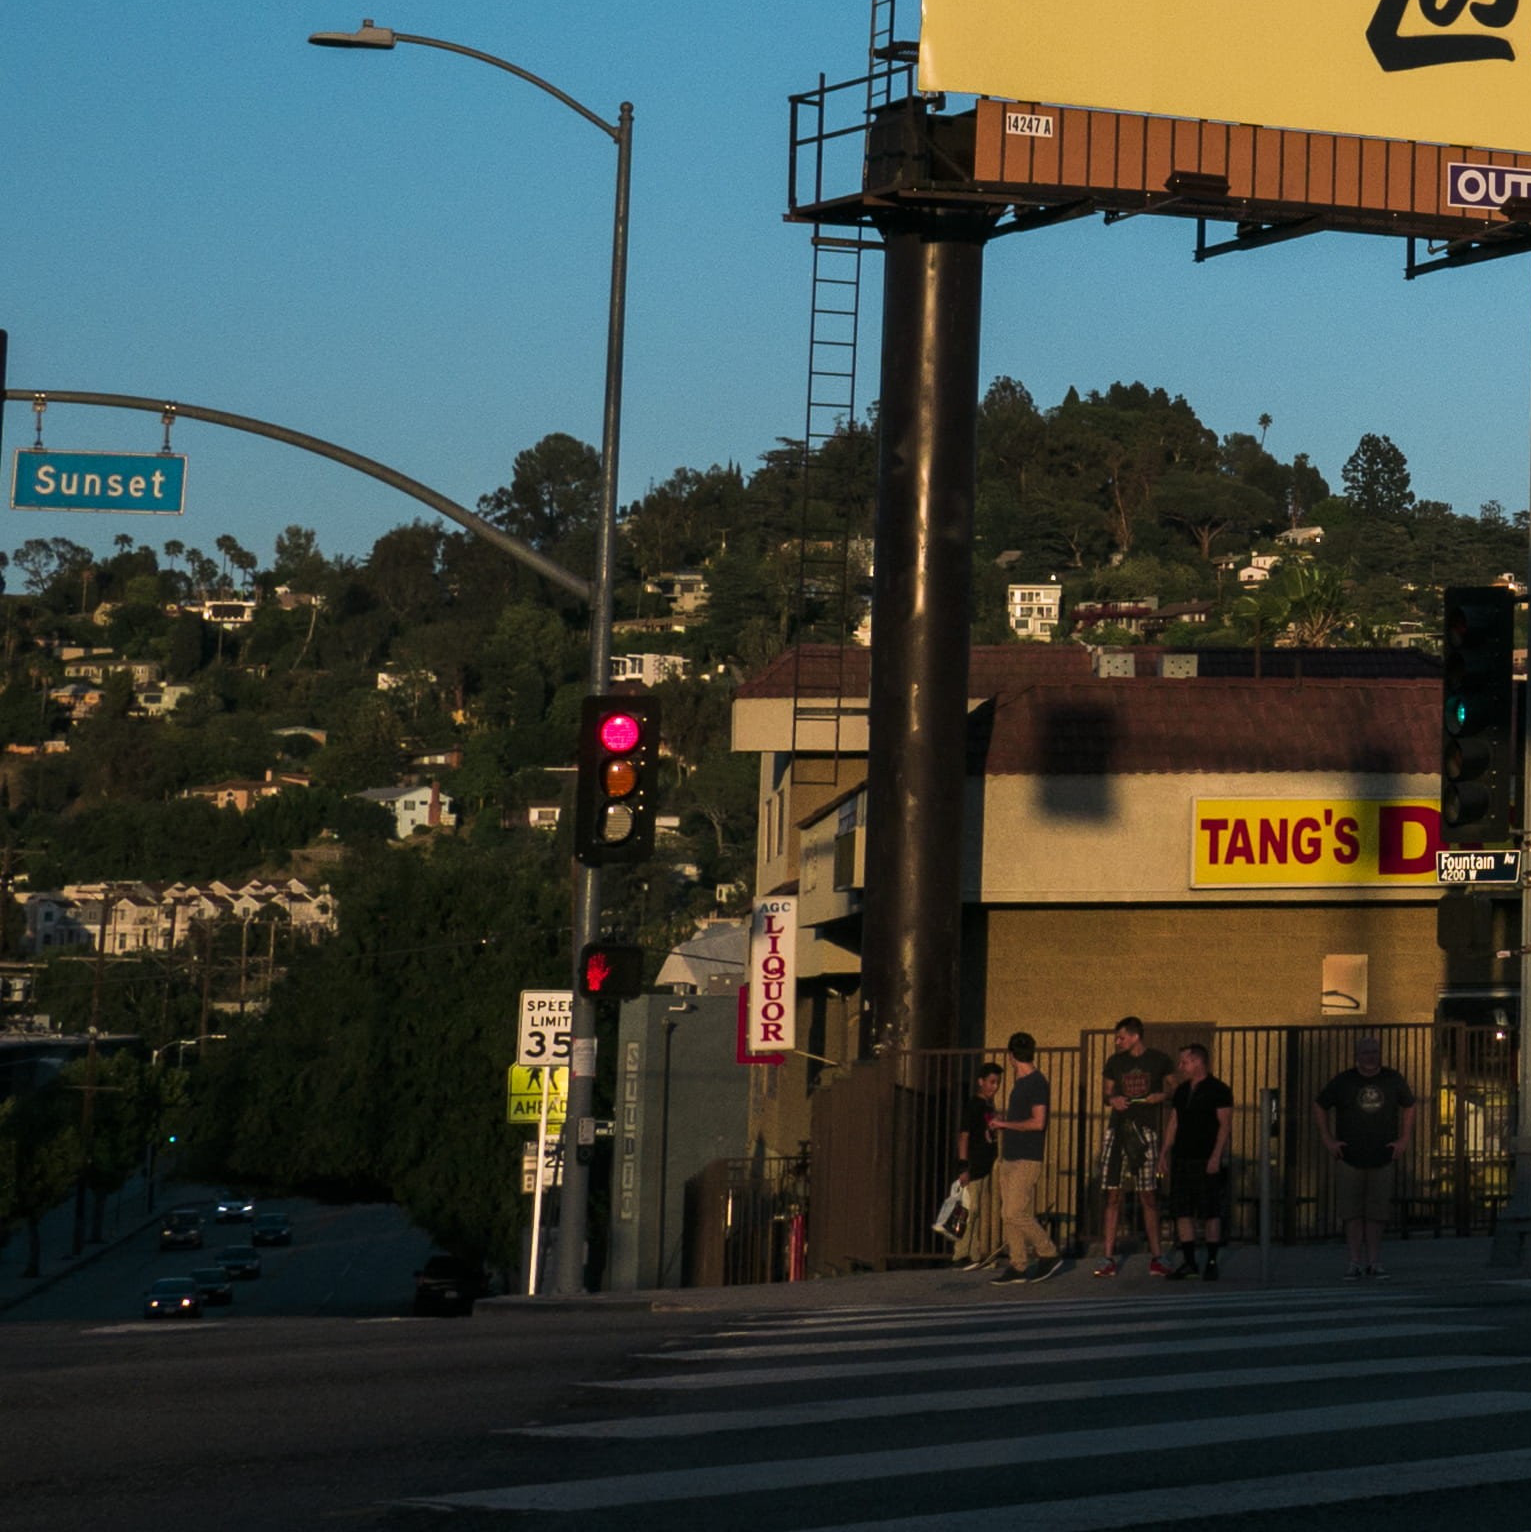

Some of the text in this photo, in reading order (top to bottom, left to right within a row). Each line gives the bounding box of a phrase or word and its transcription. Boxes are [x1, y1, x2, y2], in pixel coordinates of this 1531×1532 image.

[1008, 115, 1051, 134] 14247 A
[34, 464, 165, 499] Sunset
[1200, 809, 1360, 865] TANG'S
[1441, 852, 1516, 870] Fountain Av
[1441, 869, 1477, 881] 4200 W
[759, 902, 791, 913] AGC
[761, 915, 786, 1042] LIQUOR
[527, 1000, 573, 1012] SPEE
[531, 1016, 571, 1027] LIMIT
[525, 1031, 571, 1059] 35
